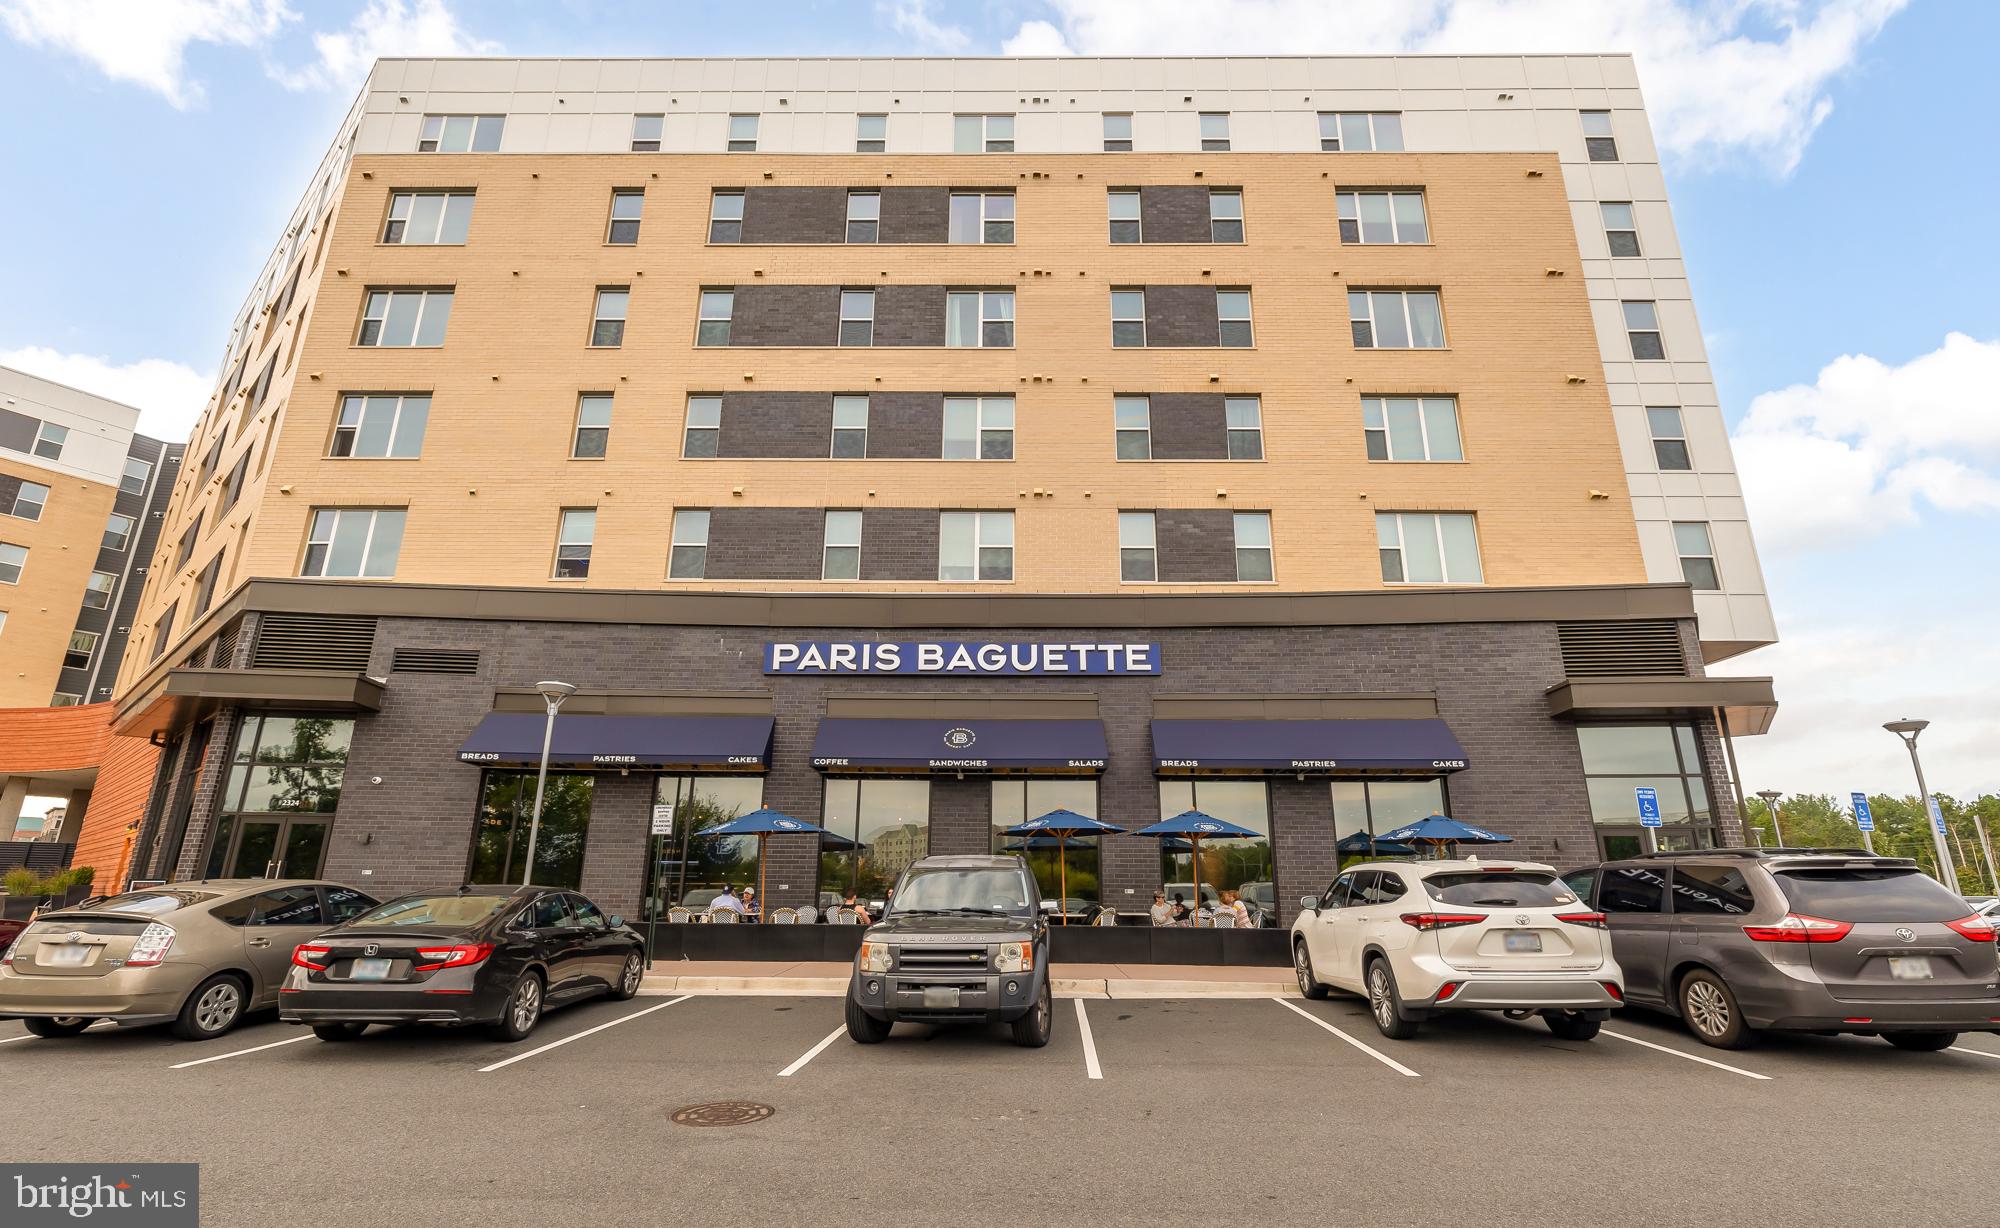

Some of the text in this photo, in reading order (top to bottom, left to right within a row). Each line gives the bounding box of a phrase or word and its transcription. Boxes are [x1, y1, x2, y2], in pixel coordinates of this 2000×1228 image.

[772, 644, 1152, 671] PARIS BAGUETTE
[592, 755, 636, 763] PASTRIES
[813, 758, 849, 766] COFFEE
[929, 759, 988, 767] SANDWICHES
[282, 799, 300, 807] 2324
